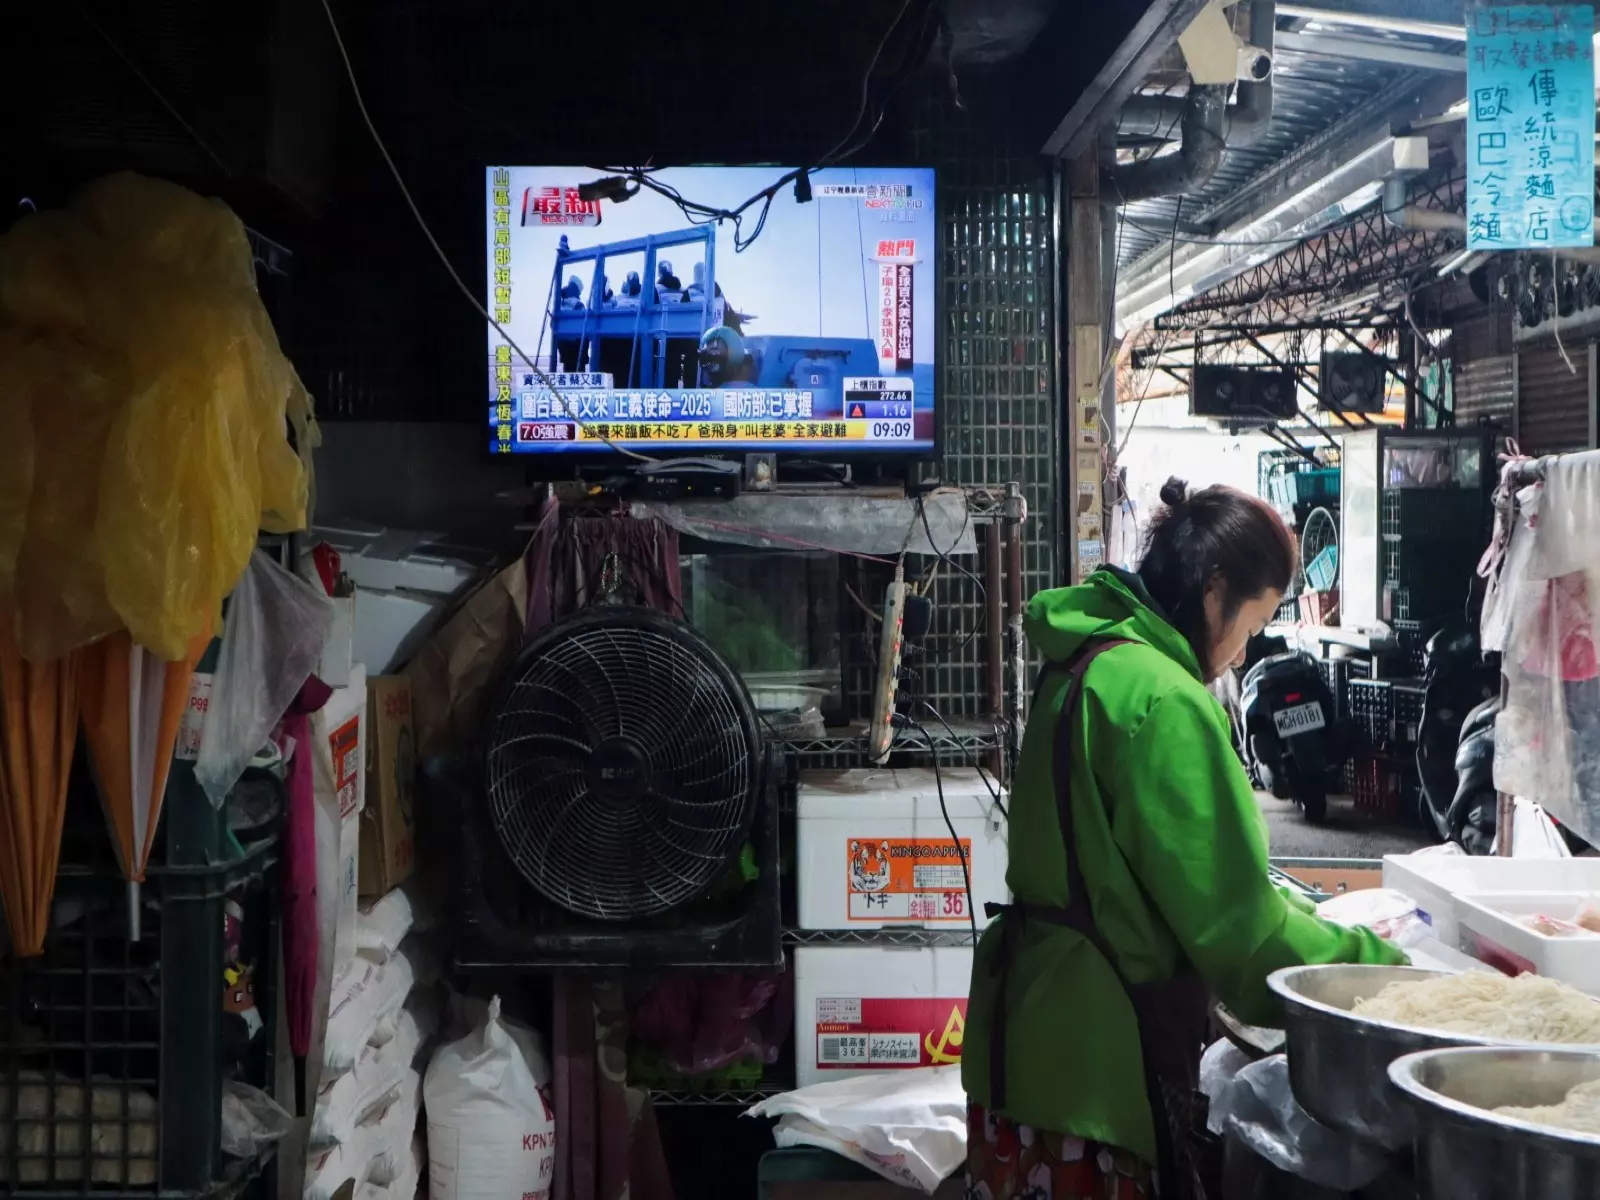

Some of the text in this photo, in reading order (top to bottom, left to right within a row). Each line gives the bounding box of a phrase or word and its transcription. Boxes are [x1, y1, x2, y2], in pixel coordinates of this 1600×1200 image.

[1524, 68, 1559, 241] 傳統涼麵店
[1470, 86, 1513, 244] 歐巴冷麵
[532, 187, 593, 215] 最新
[877, 240, 915, 257] 熱門
[880, 392, 907, 401] 272.66
[882, 404, 907, 416] 1.16
[873, 422, 912, 438] 09:09
[943, 892, 963, 915] 36
[872, 1039, 914, 1049] シナノスイート
[523, 1133, 547, 1151] KPN
